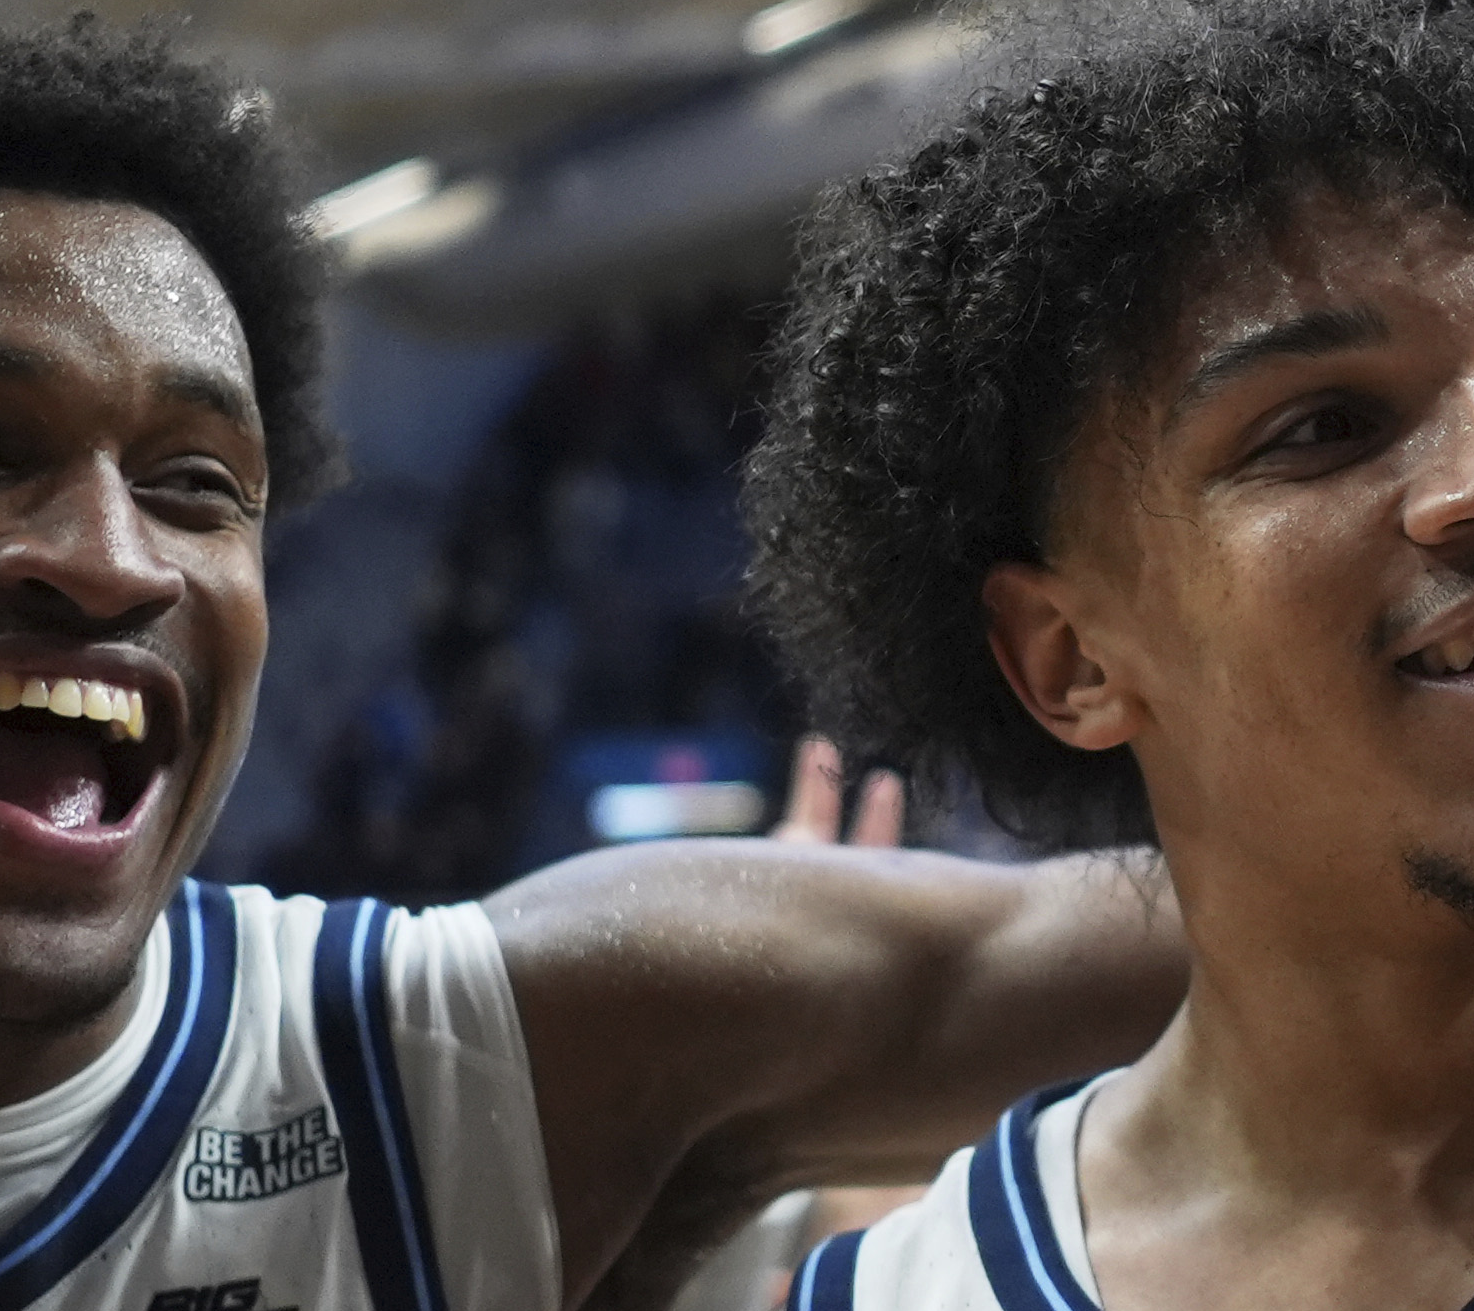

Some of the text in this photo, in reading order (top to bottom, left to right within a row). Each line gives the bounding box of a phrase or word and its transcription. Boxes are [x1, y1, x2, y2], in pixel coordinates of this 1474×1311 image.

[197, 1105, 328, 1166] BE THE
[184, 1136, 344, 1201] CHANGE
